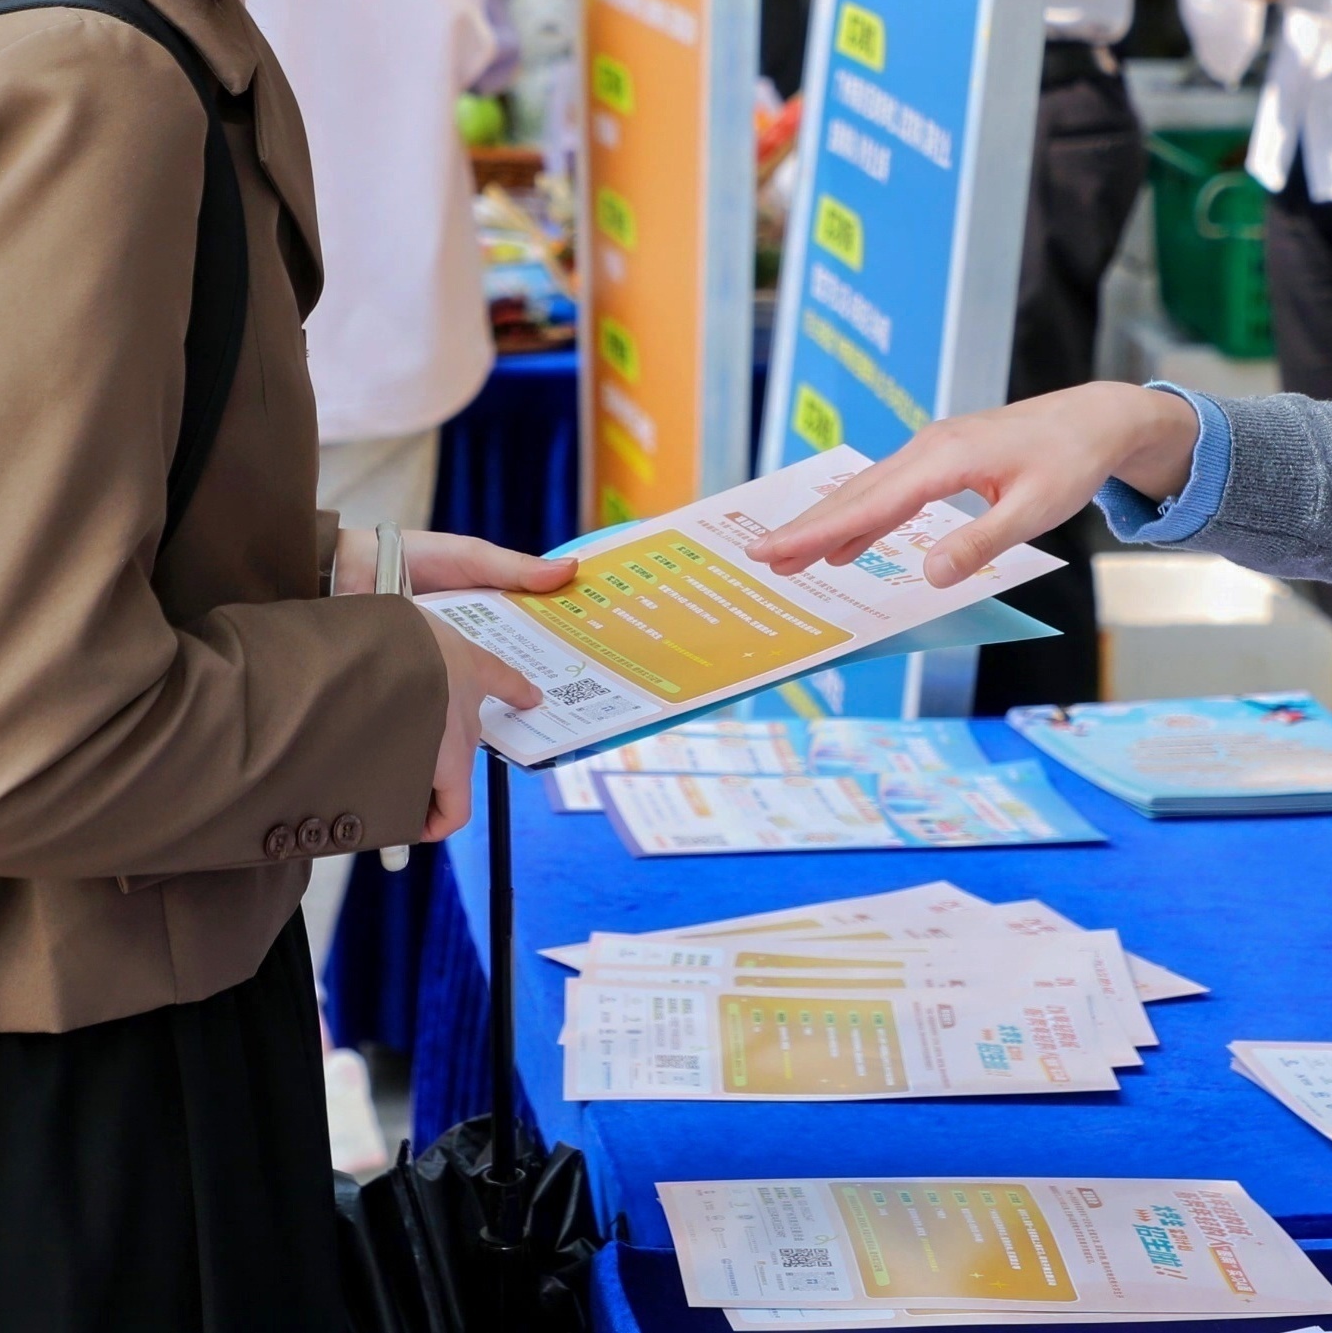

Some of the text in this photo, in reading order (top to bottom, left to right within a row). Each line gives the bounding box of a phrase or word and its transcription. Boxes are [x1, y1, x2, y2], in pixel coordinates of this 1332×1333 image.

[846, 551, 925, 588] 生啦!!
[1147, 1205, 1189, 1227] 大学生
[1129, 1223, 1192, 1279] 招生啦!!
